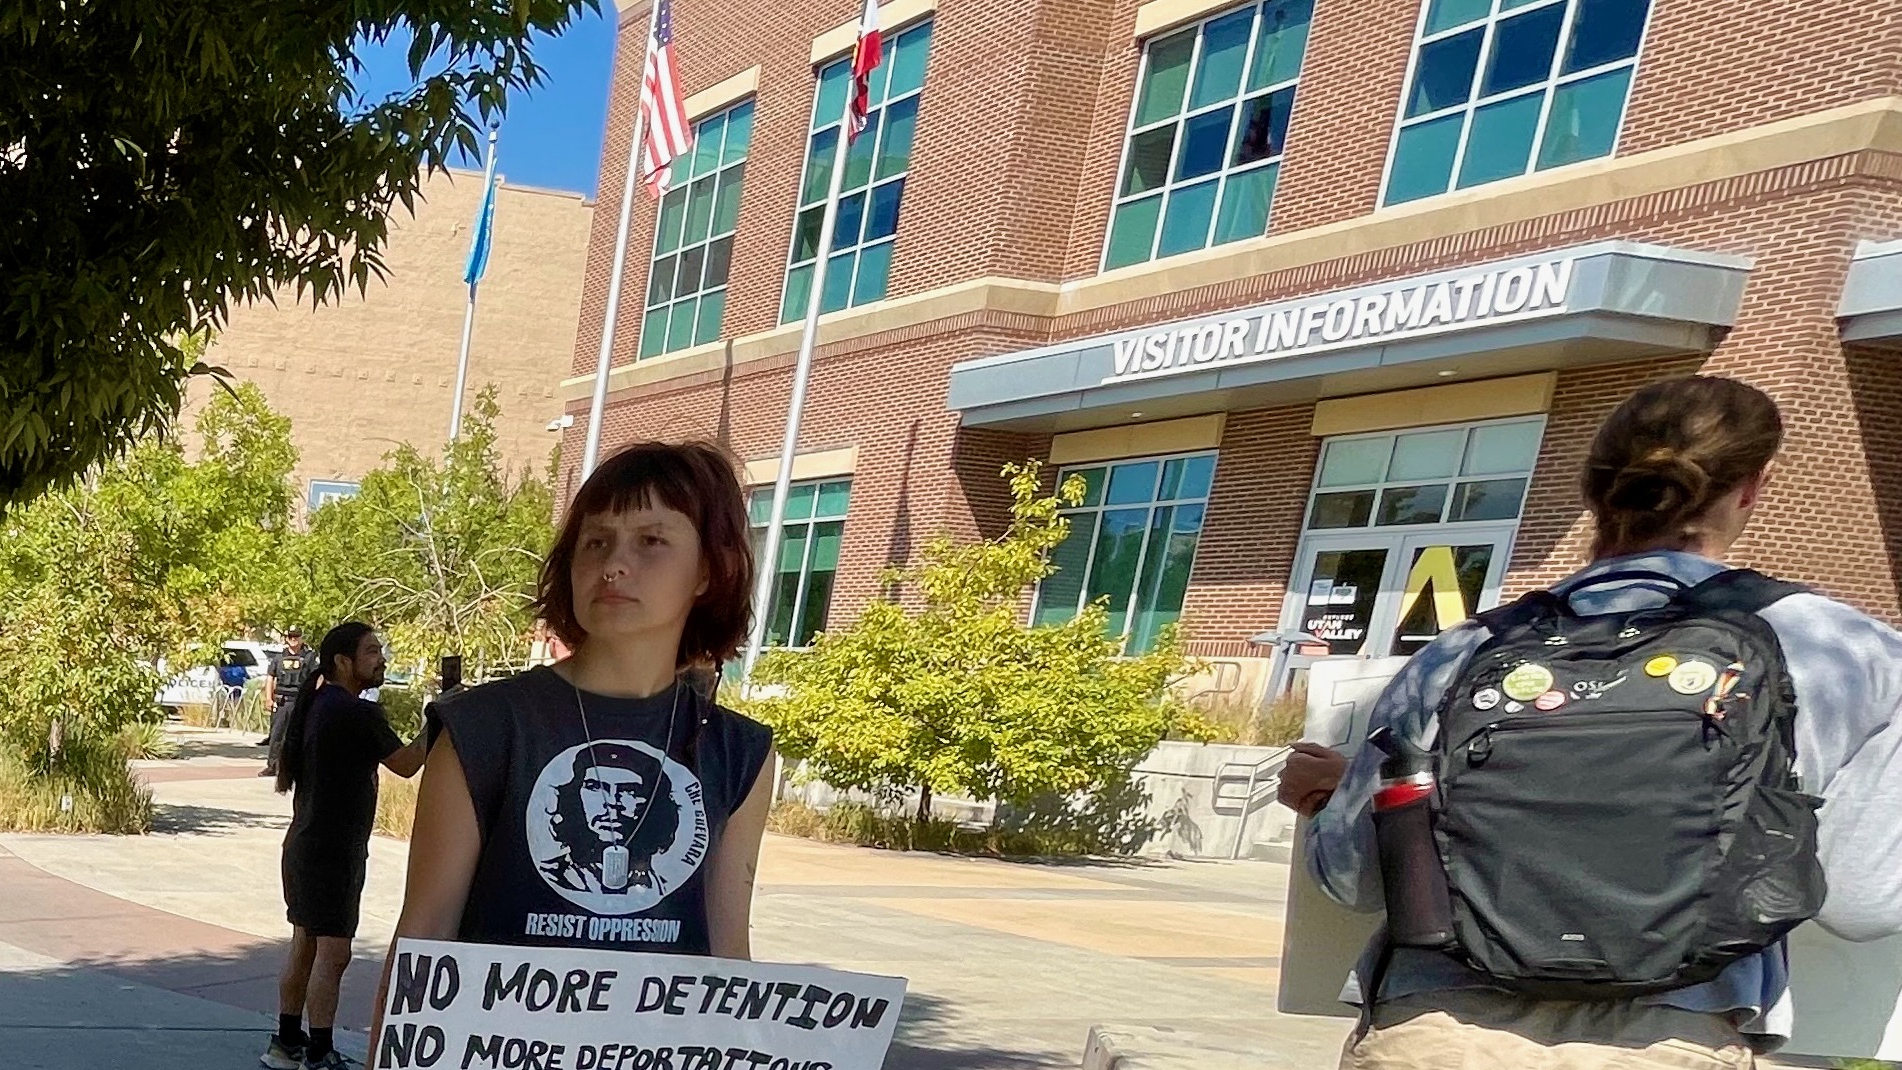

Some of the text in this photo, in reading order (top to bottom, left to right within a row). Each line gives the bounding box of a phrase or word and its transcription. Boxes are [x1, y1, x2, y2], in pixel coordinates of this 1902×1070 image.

[1112, 258, 1575, 376] VISITOR INFORMATION
[681, 810, 707, 867] GUEVARA
[524, 912, 682, 943] RESIST OPPRESSION
[390, 952, 890, 1031] NO MORE DETENTION
[379, 1023, 445, 1070] NO
